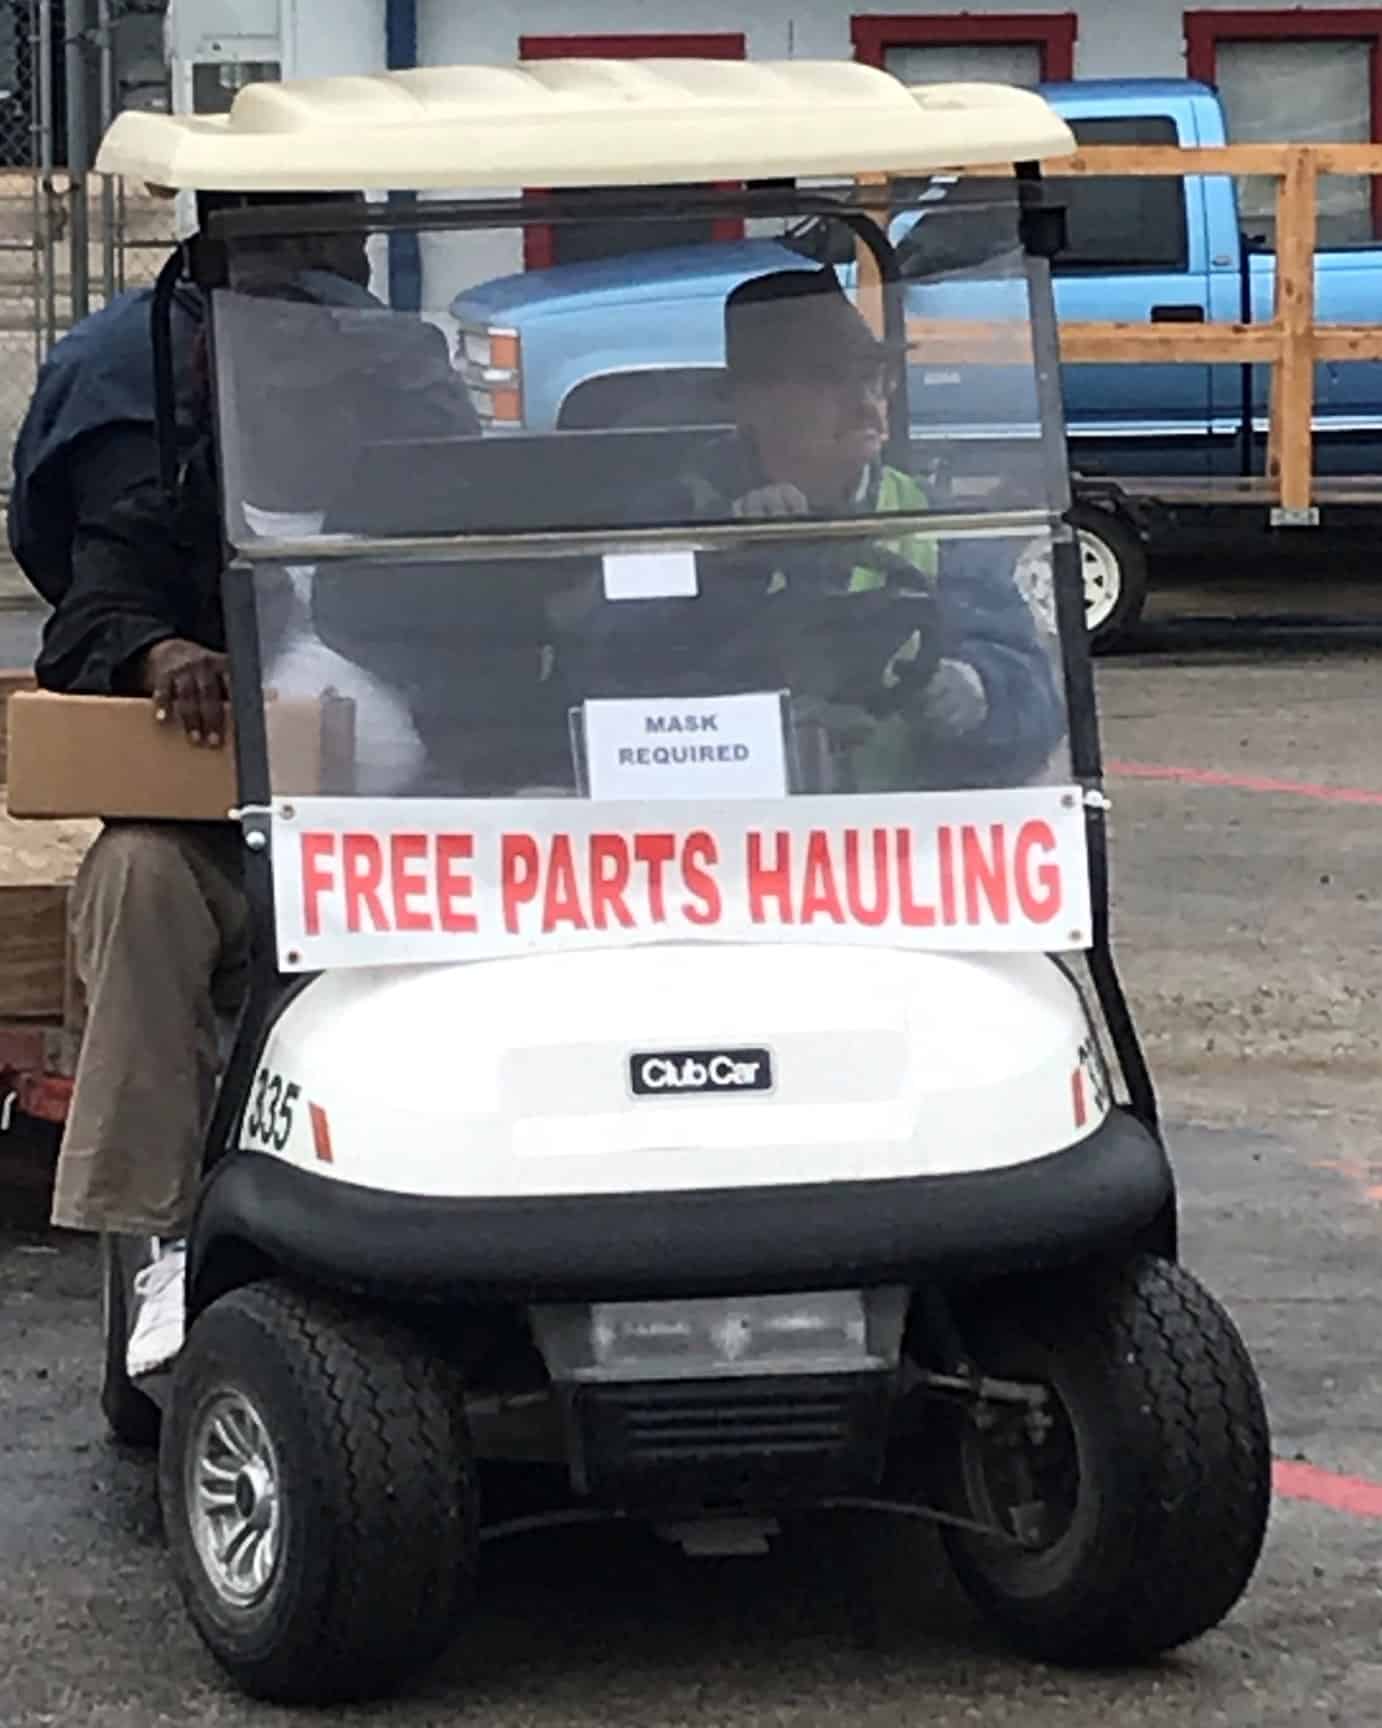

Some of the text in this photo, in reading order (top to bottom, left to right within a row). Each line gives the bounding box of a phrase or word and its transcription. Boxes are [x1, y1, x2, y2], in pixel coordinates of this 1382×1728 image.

[644, 714, 718, 733] MASK
[618, 744, 750, 765] REQUIRED
[301, 819, 1062, 936] FREE PARTS HAULING
[641, 1055, 760, 1088] Club Car
[248, 1067, 302, 1151] 335
